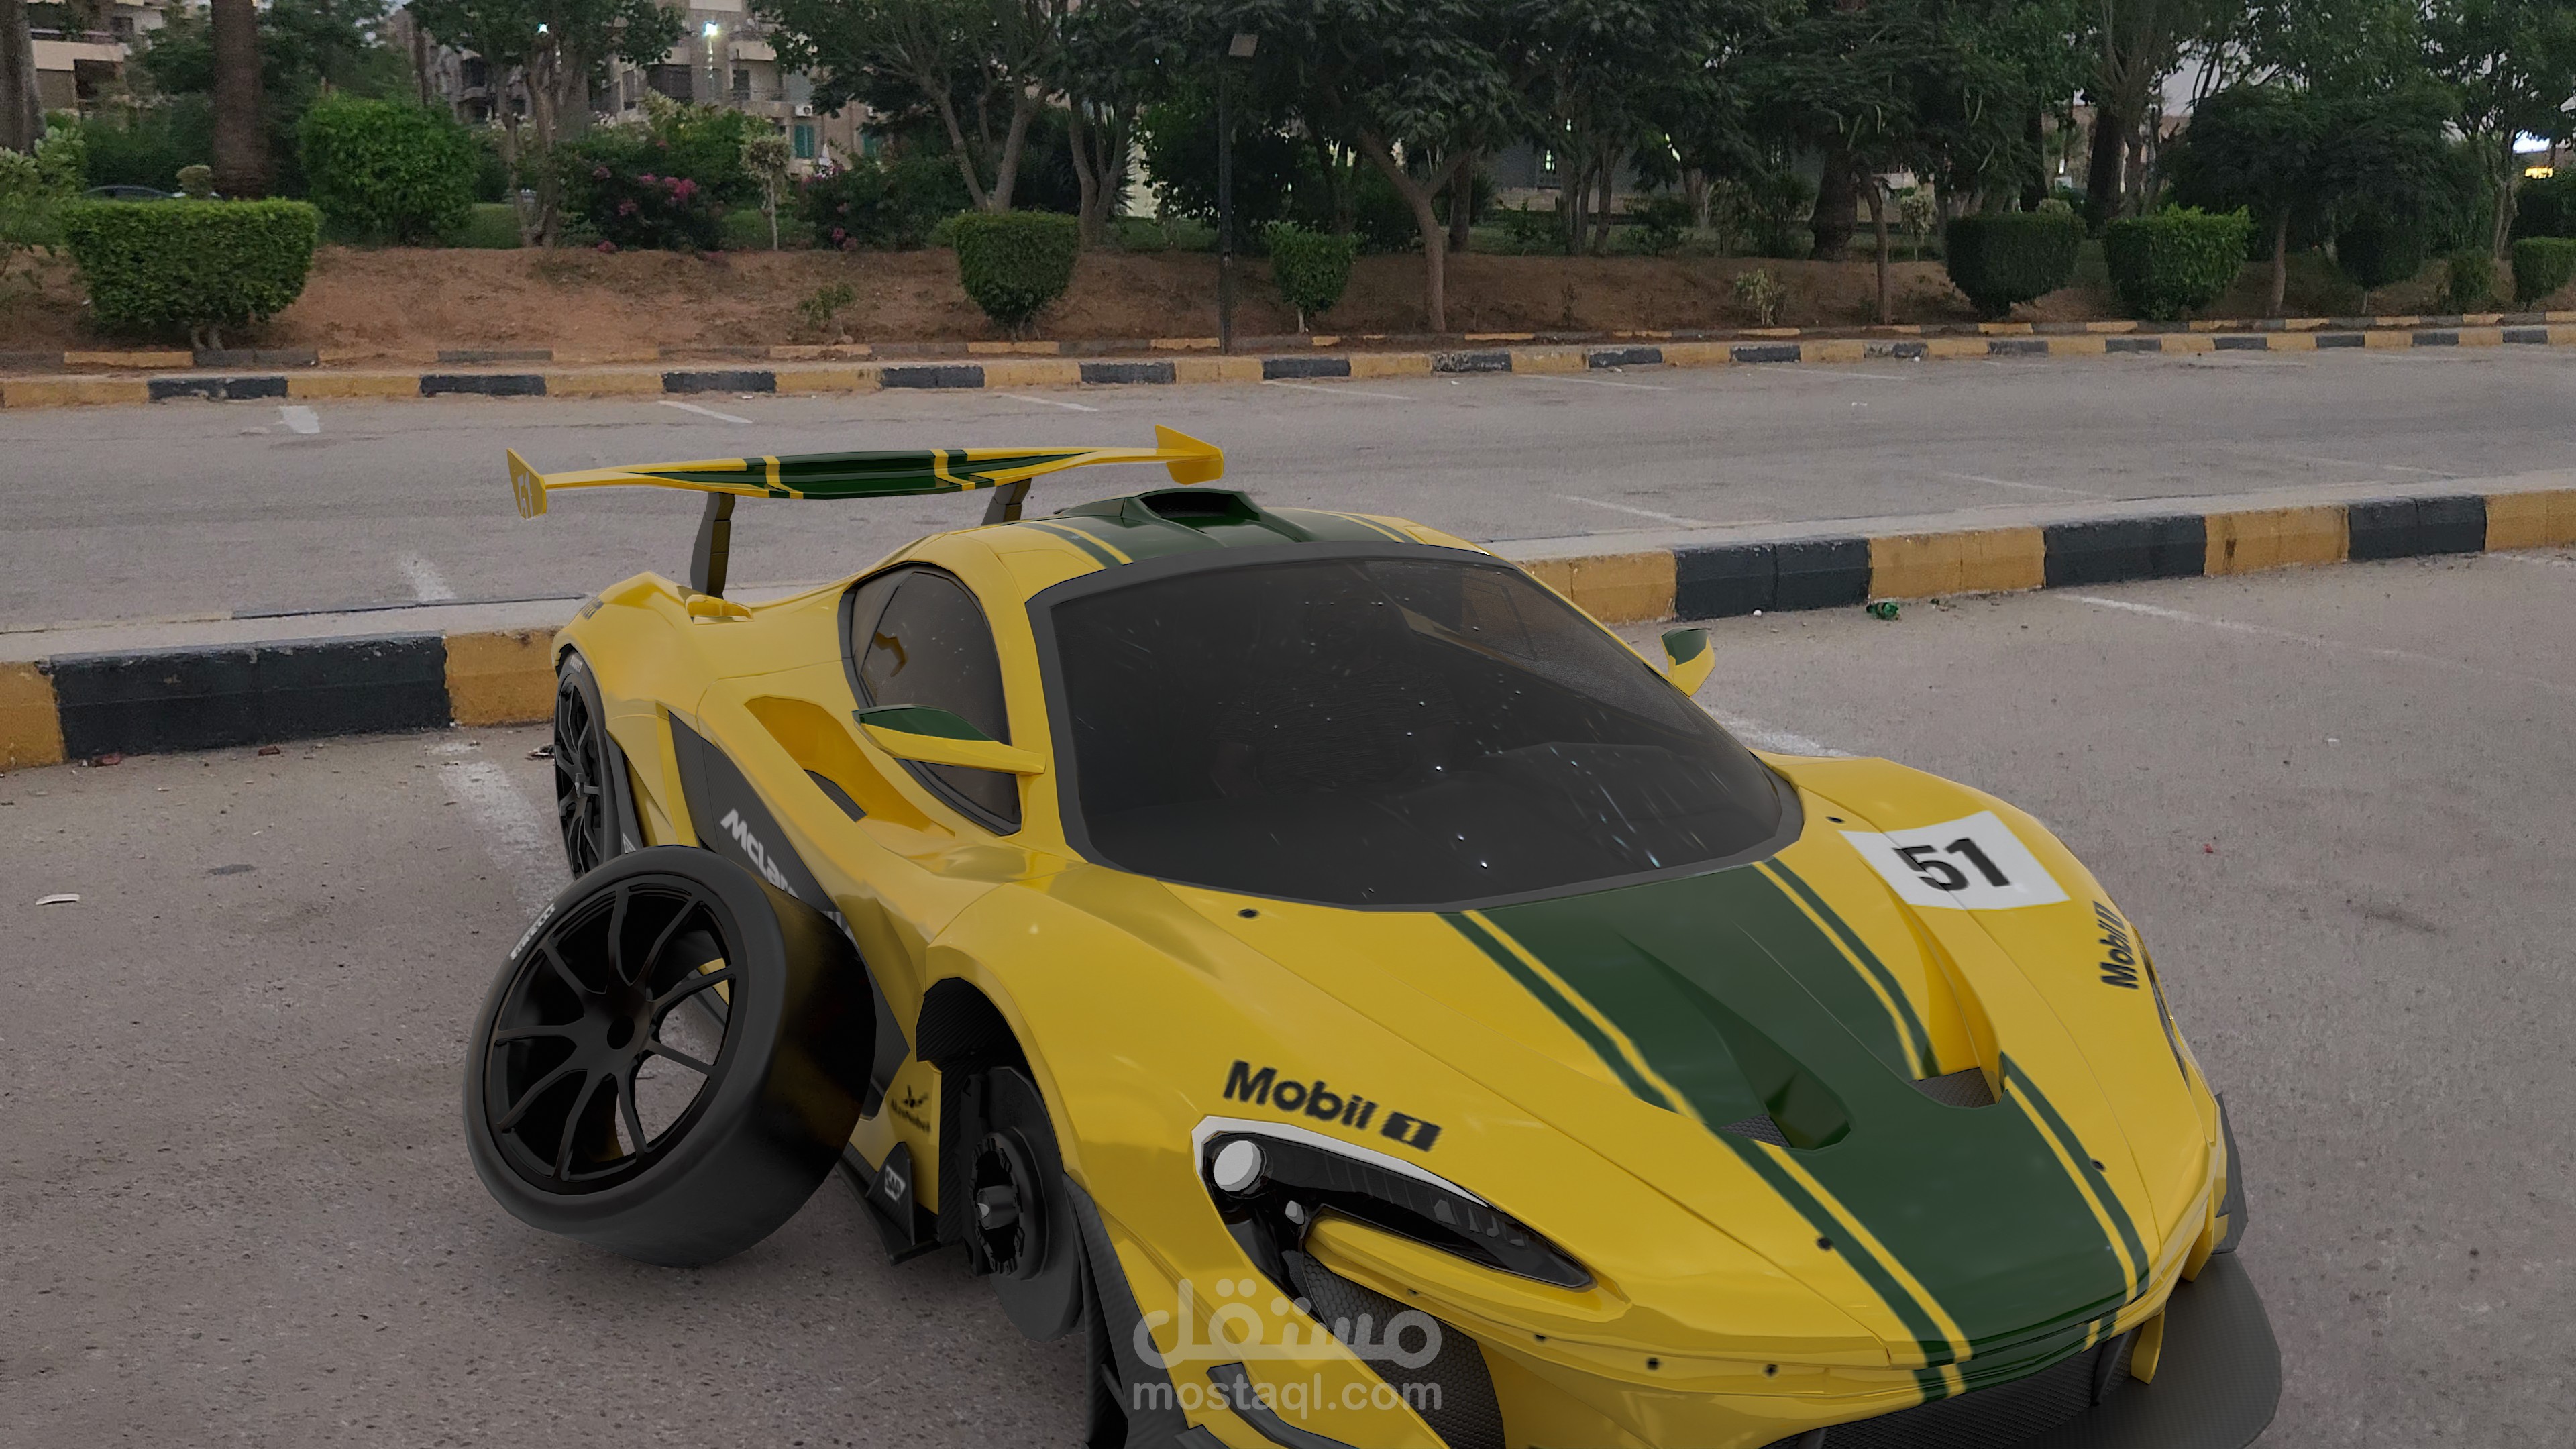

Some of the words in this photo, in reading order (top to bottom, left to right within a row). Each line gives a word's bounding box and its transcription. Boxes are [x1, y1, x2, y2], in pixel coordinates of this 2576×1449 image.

[720, 808, 800, 900] McLar
[1892, 837, 2011, 892] 51
[2098, 918, 2140, 990] Mobil
[1223, 1059, 1378, 1130] Mobil
